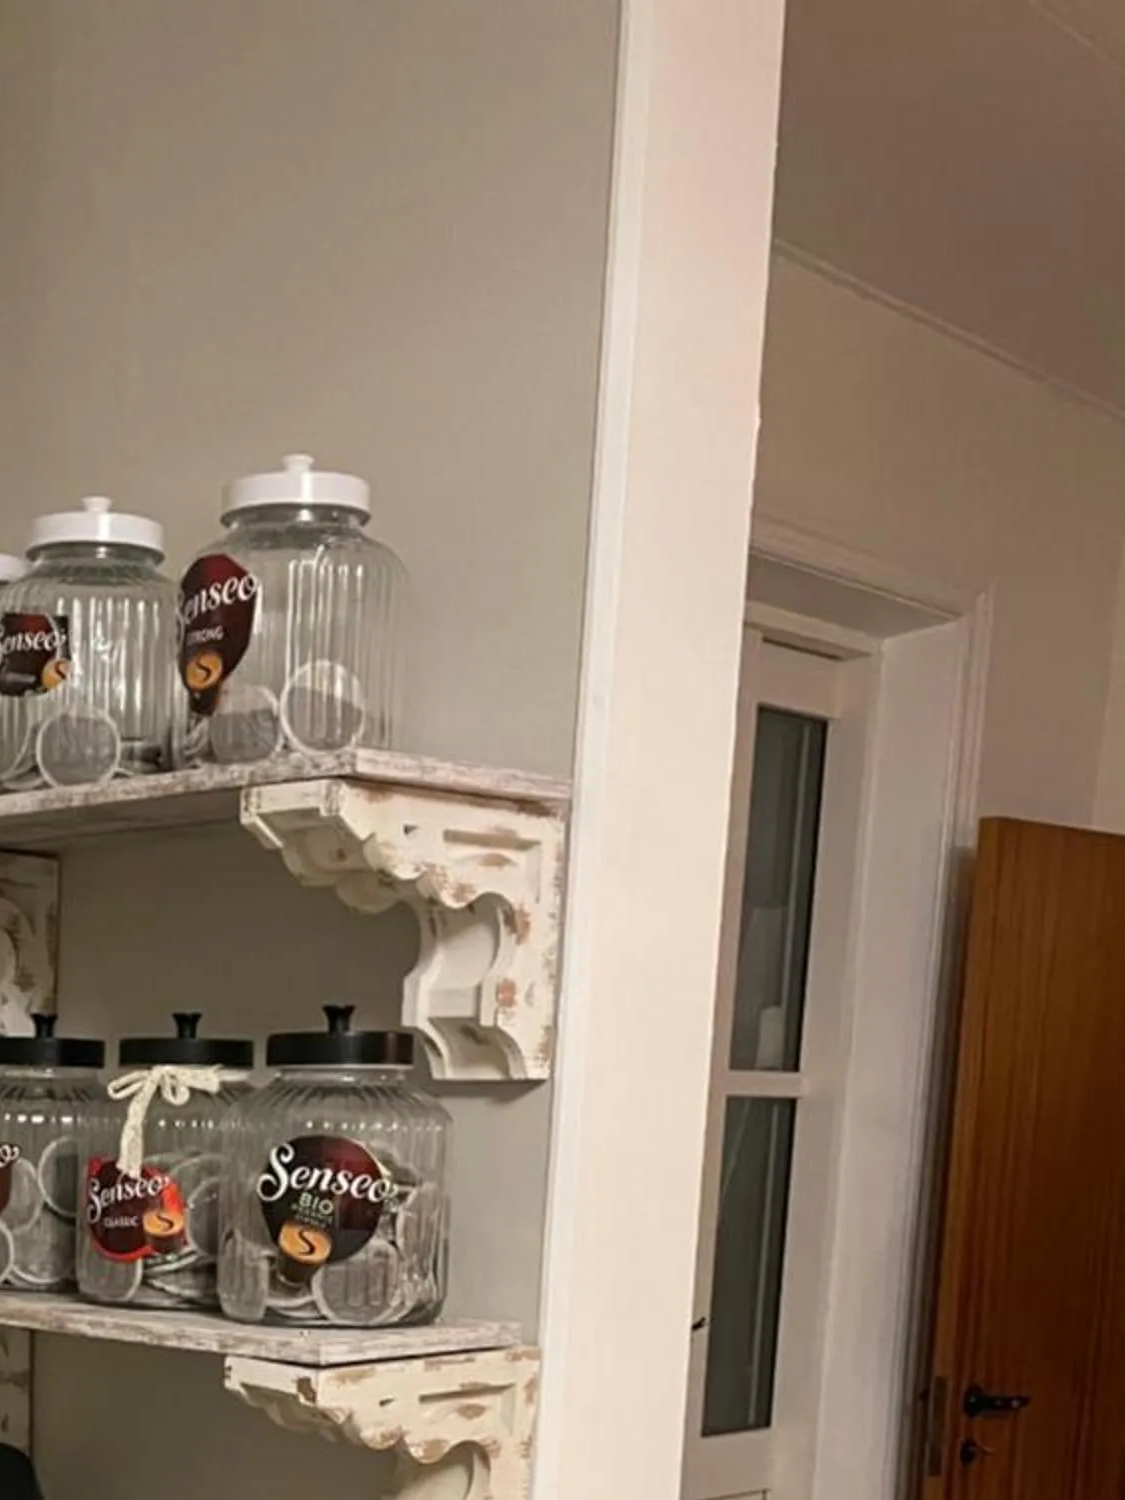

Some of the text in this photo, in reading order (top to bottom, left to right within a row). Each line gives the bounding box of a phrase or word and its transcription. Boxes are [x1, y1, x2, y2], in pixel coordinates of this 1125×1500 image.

[256, 1143, 399, 1203] Senseo
[86, 1176, 170, 1224] Senseo
[299, 1192, 334, 1215] BIO
